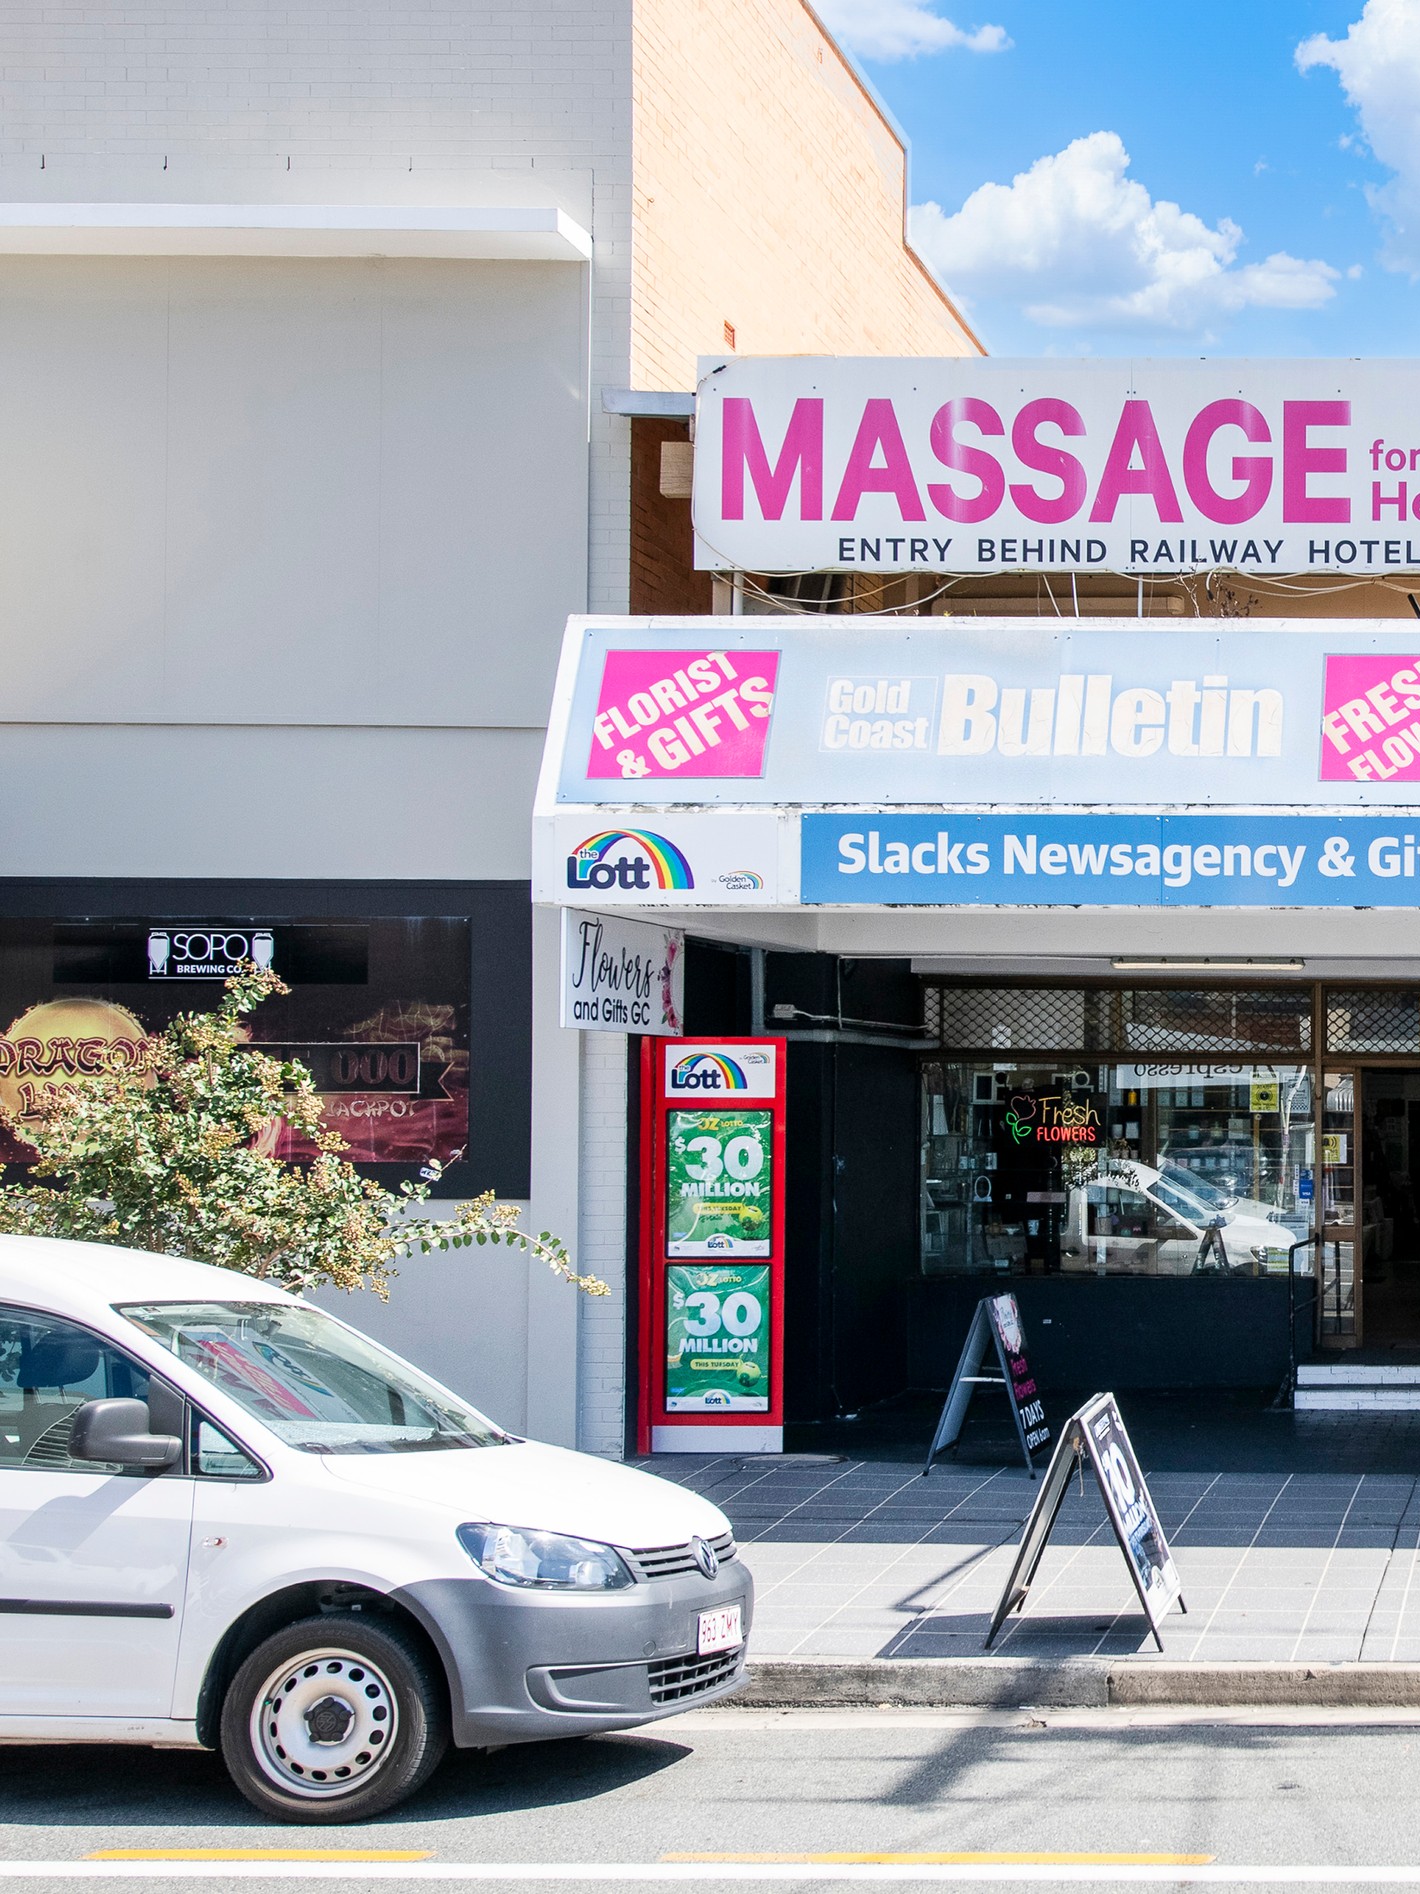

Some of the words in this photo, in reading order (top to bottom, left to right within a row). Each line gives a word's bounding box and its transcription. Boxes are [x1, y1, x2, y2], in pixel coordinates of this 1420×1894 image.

[721, 397, 1351, 525] MASSAGE
[838, 538, 953, 562] ENTRY
[977, 538, 1107, 563] BEHIND
[1130, 539, 1285, 564] RAILWAY
[594, 651, 739, 750] FLORIST
[828, 679, 911, 714] Gold
[616, 749, 652, 779] &
[647, 676, 774, 770] GIFTS
[937, 674, 1284, 757] Bulletin
[824, 713, 930, 750] Coast
[579, 848, 598, 860] the
[837, 831, 990, 877] Slacks
[1003, 835, 1307, 888] Newsagency
[1317, 836, 1357, 878] &
[566, 855, 651, 890] Lott
[718, 874, 747, 883] Golden
[725, 881, 752, 890] Casket
[172, 933, 249, 961] SOPO
[572, 917, 655, 999] Flowers
[176, 964, 226, 974] BREWING
[573, 997, 599, 1021] and
[602, 998, 628, 1024] Gifts
[631, 1001, 651, 1026] GC
[671, 1069, 721, 1090] Lott
[325, 1100, 419, 1118] JACKPOT
[1038, 1096, 1101, 1126] Fresh
[1036, 1126, 1096, 1142] FLOWERS
[674, 1135, 764, 1181] $30
[682, 1181, 761, 1198] MILLION
[672, 1290, 762, 1337] $30
[679, 1337, 759, 1354] MILLION
[1019, 1408, 1027, 1430] 7
[1025, 1400, 1045, 1428] DAYS
